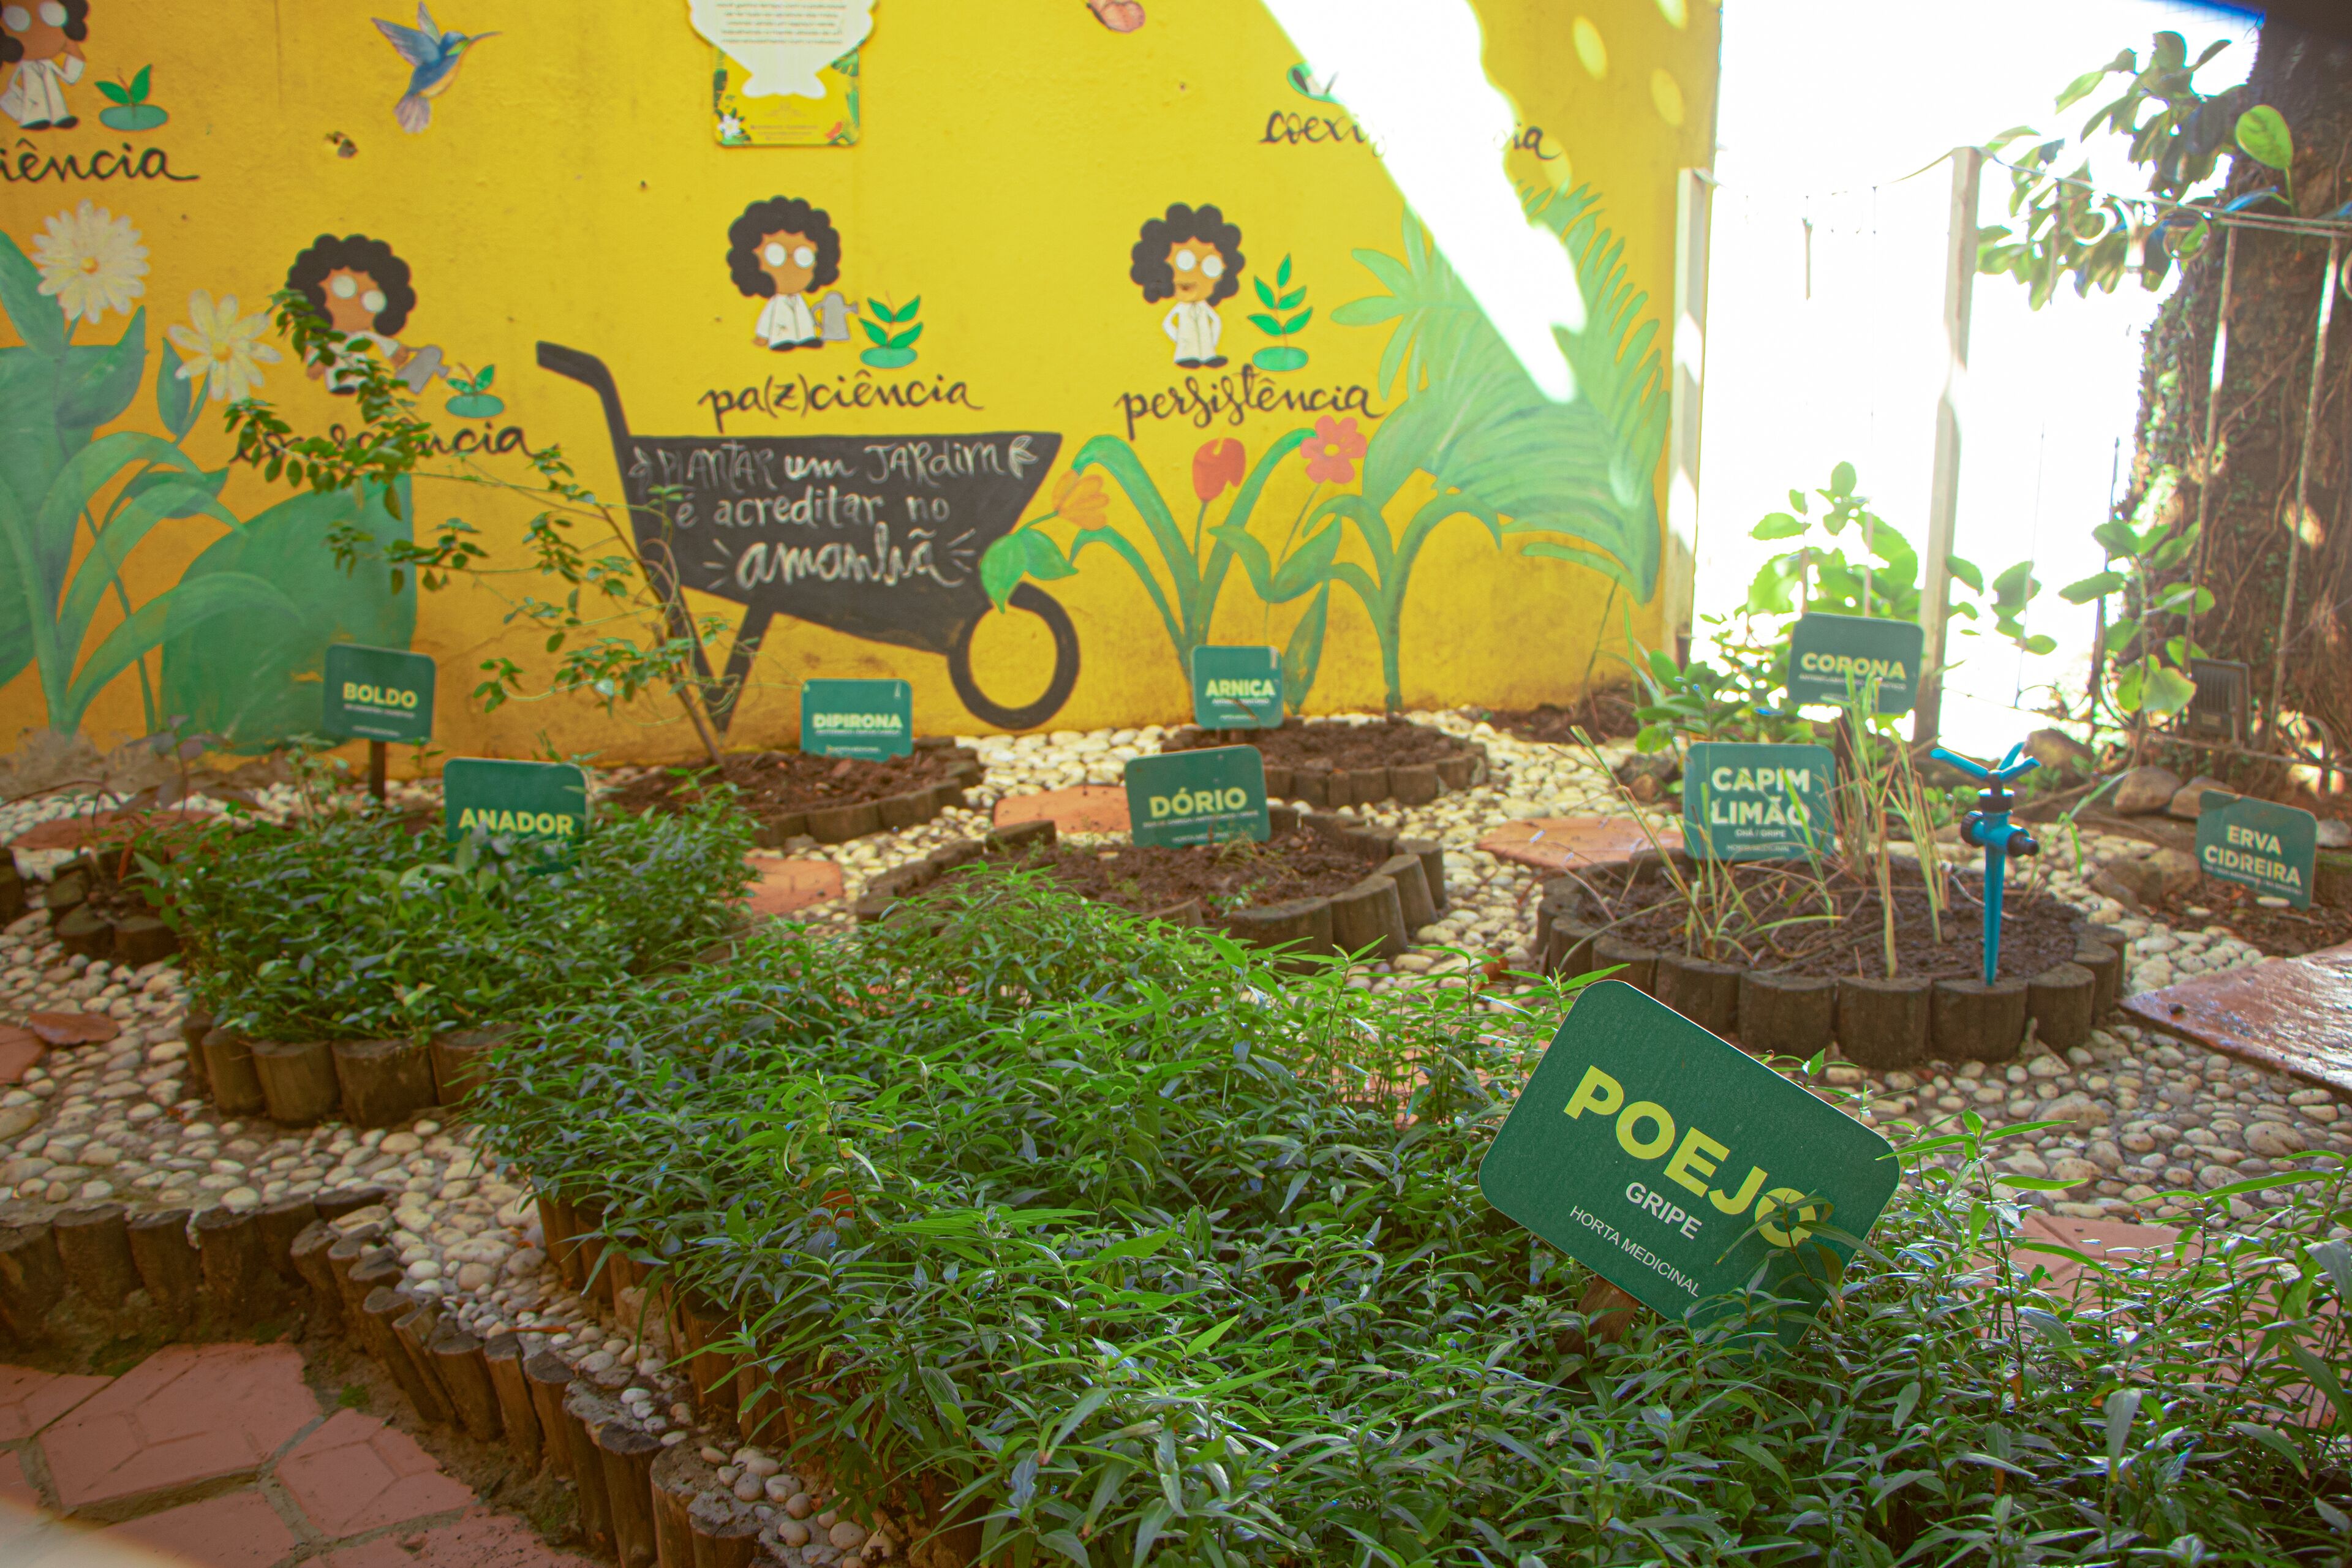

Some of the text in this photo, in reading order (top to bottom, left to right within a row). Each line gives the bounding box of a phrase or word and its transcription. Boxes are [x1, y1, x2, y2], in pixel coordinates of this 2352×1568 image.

[697, 369, 984, 434] pa(z)ciência
[1114, 363, 1386, 441] persistência
[784, 451, 856, 481] um
[676, 485, 950, 528] é acreditar no
[736, 521, 964, 589] amanhã
[1800, 652, 1907, 680] CORONA
[342, 681, 419, 709] BOLDO
[1205, 678, 1276, 697] ARNICA
[813, 713, 903, 729] DIPIRONA
[1711, 766, 1810, 793] CAPIM
[1149, 786, 1248, 818] DÓRIO
[1711, 795, 1811, 826] LIMÃO
[458, 807, 575, 835] ANADOR
[2226, 824, 2282, 856] ERVA
[2204, 844, 2302, 887] CIDREIRA
[1563, 1065, 1816, 1247] POEJO
[1625, 1182, 1702, 1240] GRIPE
[1569, 1205, 1700, 1297] HORTA MEDICINAL
